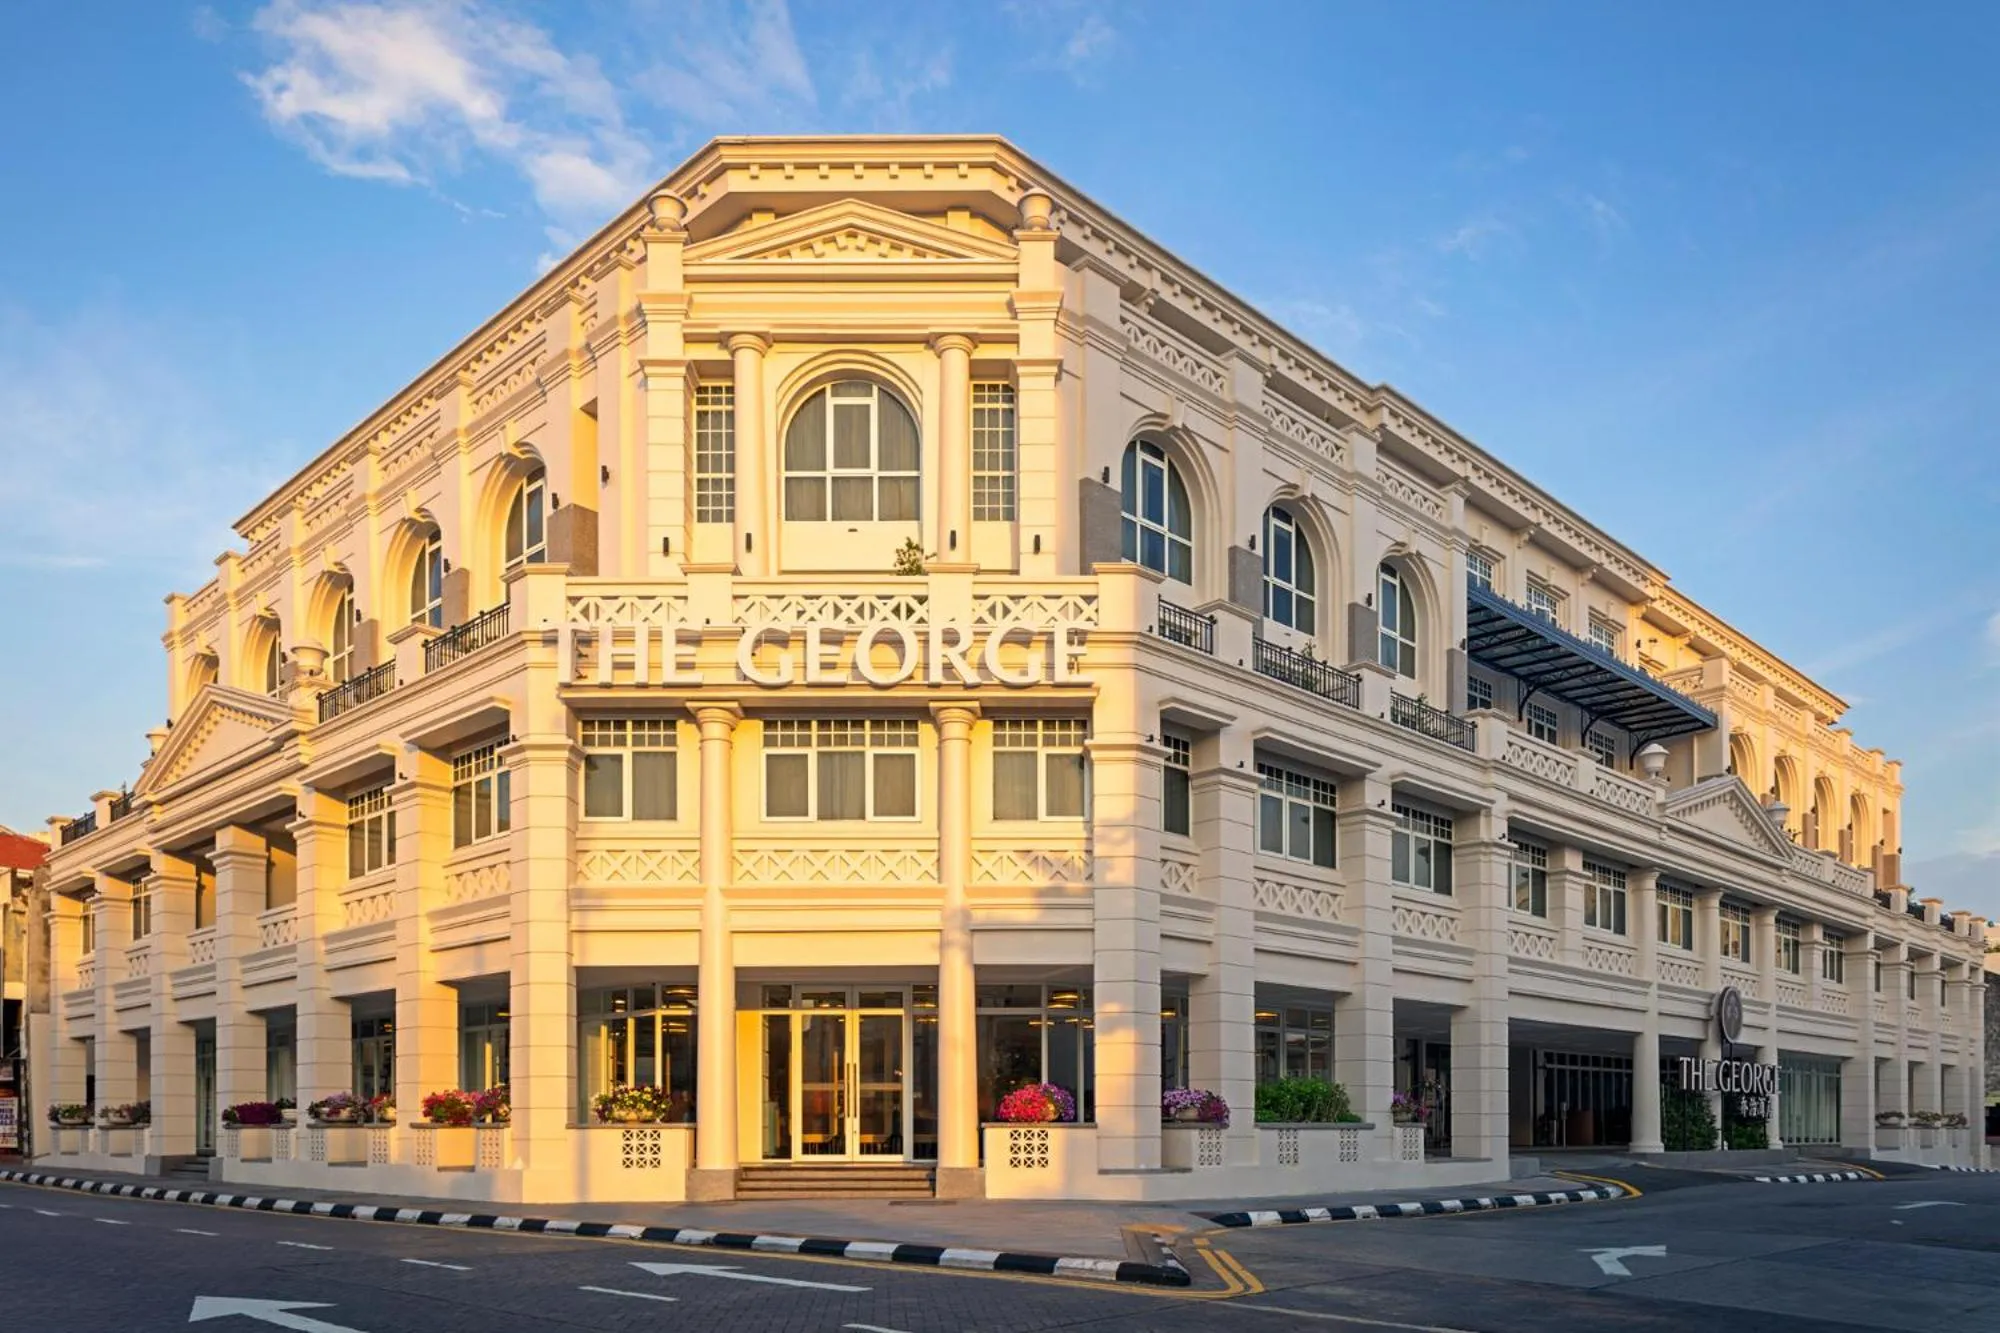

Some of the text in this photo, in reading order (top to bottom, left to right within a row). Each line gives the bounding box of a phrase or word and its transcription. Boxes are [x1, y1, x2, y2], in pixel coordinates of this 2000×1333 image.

[539, 620, 1096, 688] THE GEORGE
[1680, 1056, 1782, 1095] THE GEORGE
